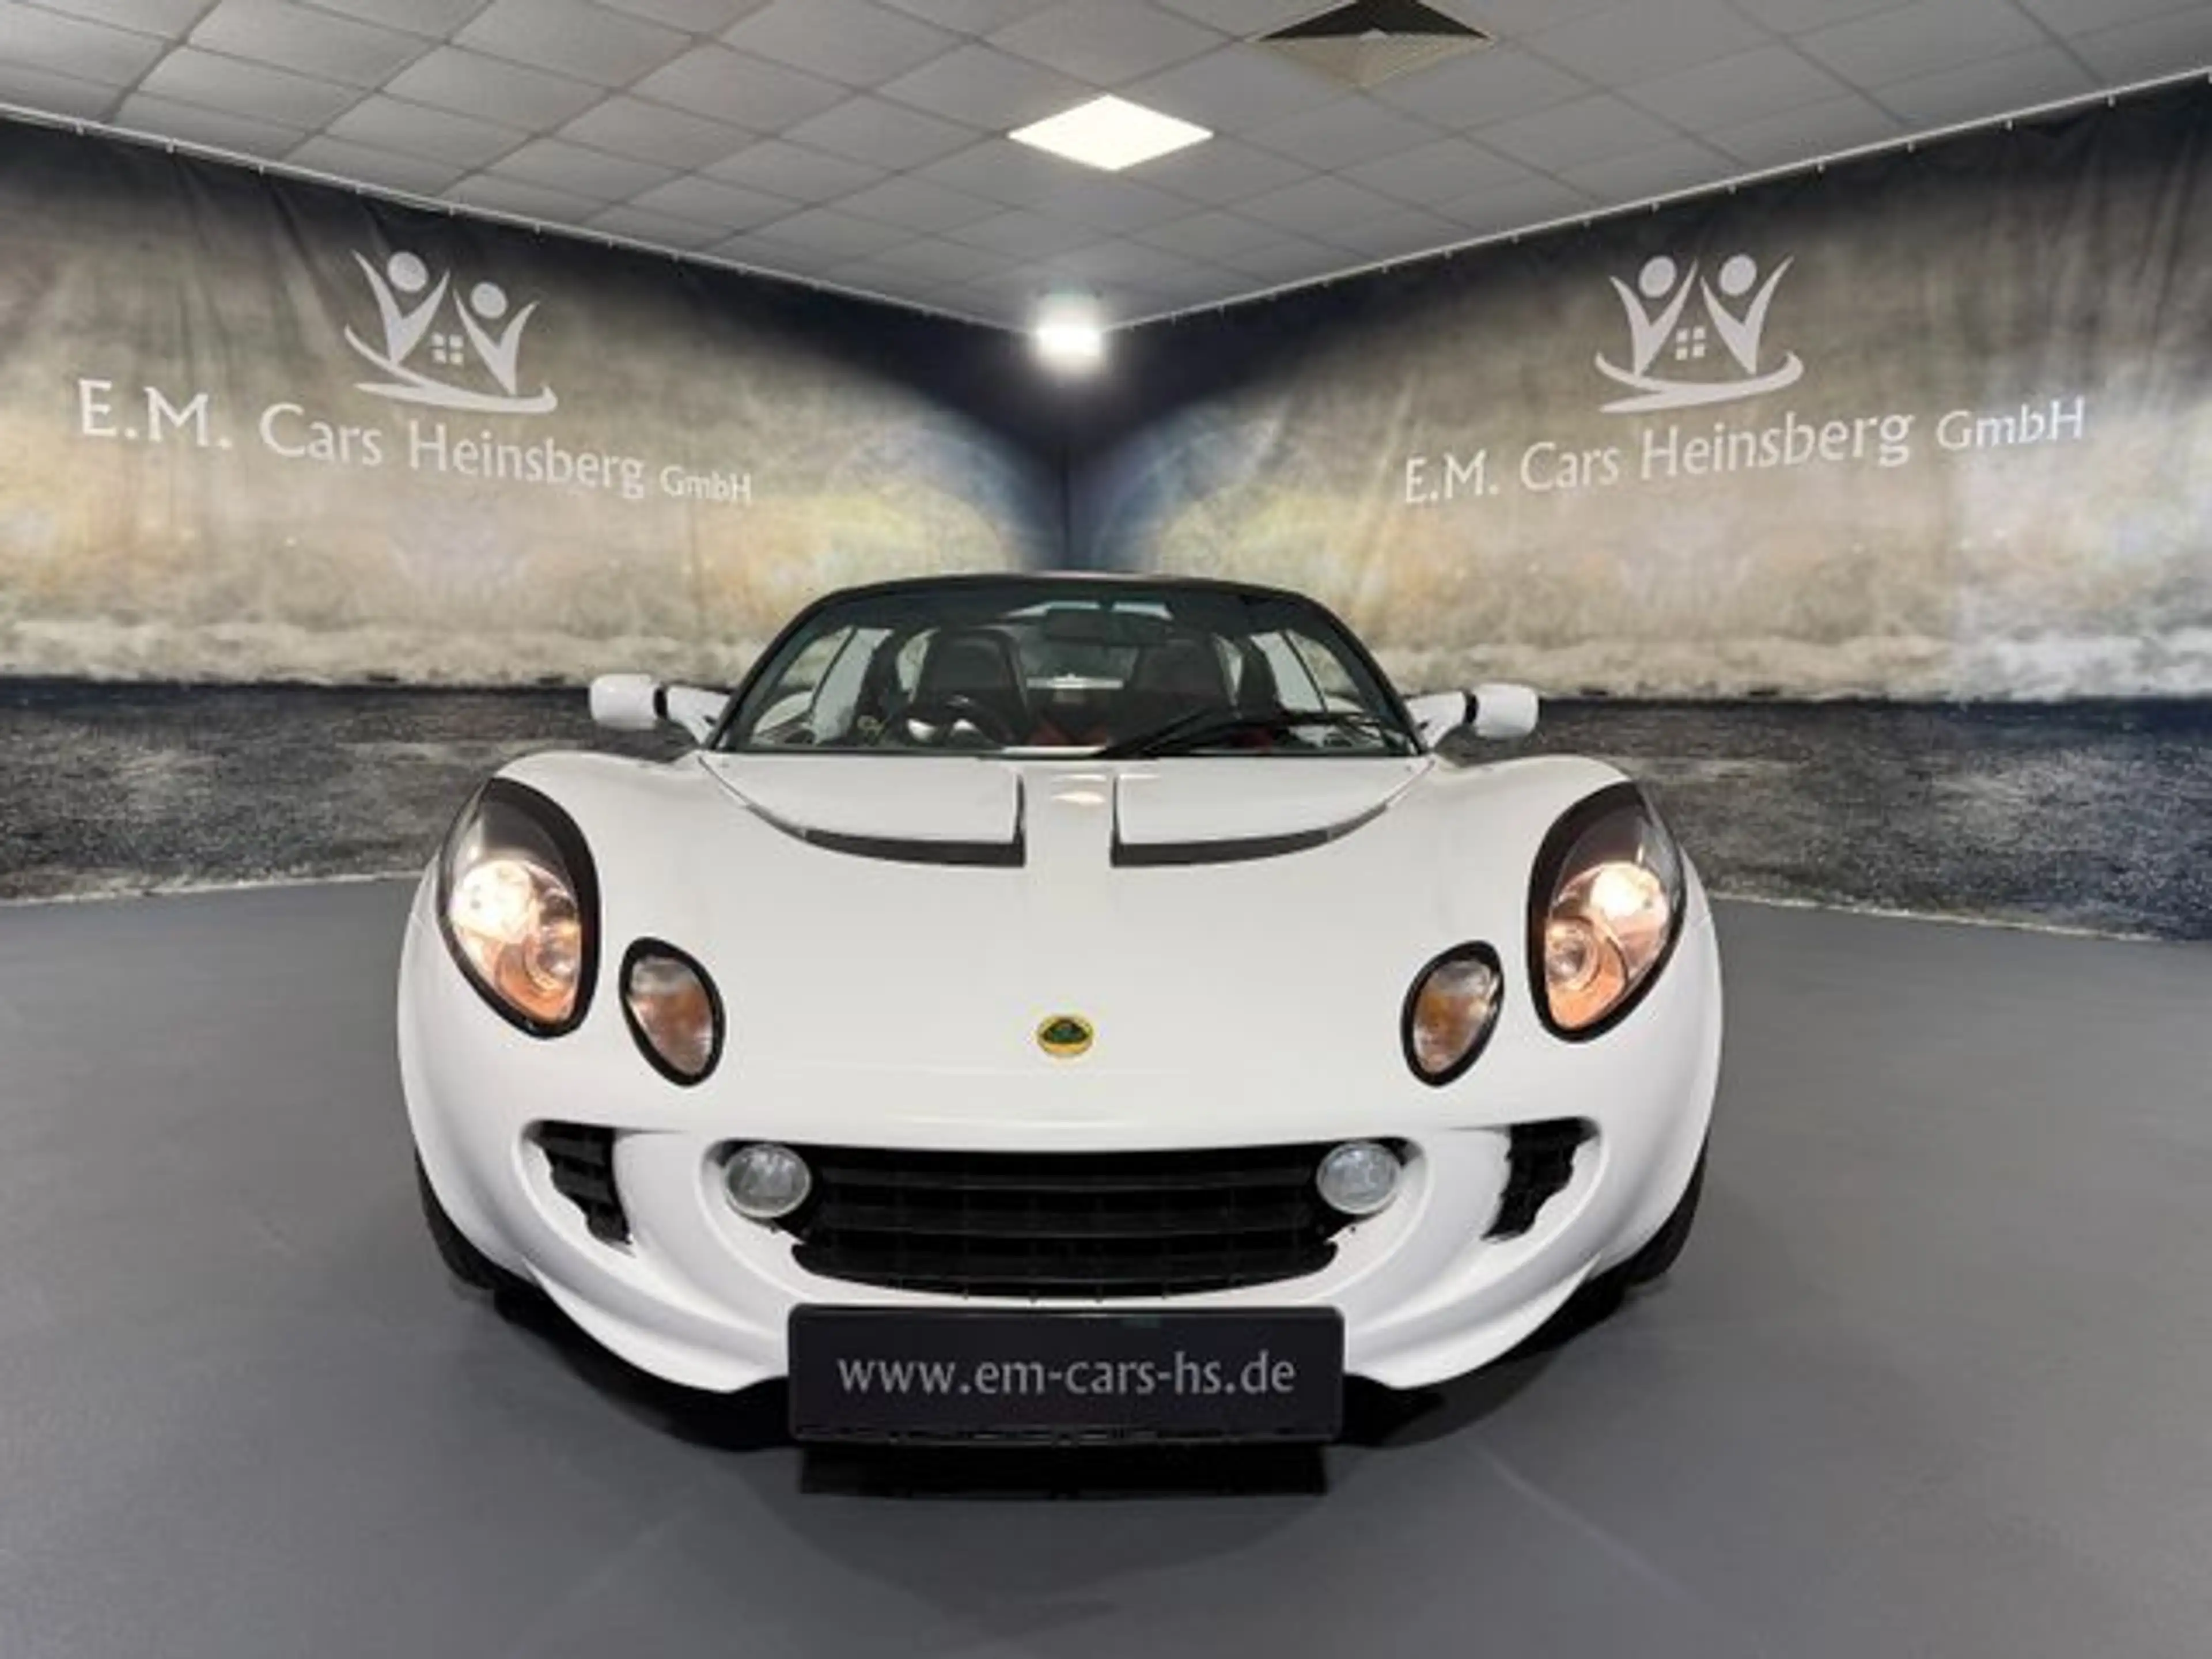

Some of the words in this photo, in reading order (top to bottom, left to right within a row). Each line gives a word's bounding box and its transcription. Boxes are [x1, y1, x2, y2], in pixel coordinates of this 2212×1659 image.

[78, 378, 233, 450] E.M.
[258, 403, 383, 468] Cars
[408, 421, 645, 500] Heinsberg
[660, 465, 753, 504] GmbH
[1403, 449, 1499, 504] E.M.
[1520, 441, 1620, 493] Cars
[1641, 410, 1916, 479] Heinsberg
[1936, 396, 2085, 452] GmbH
[837, 1350, 1297, 1395] www.em-cars-hs.de
